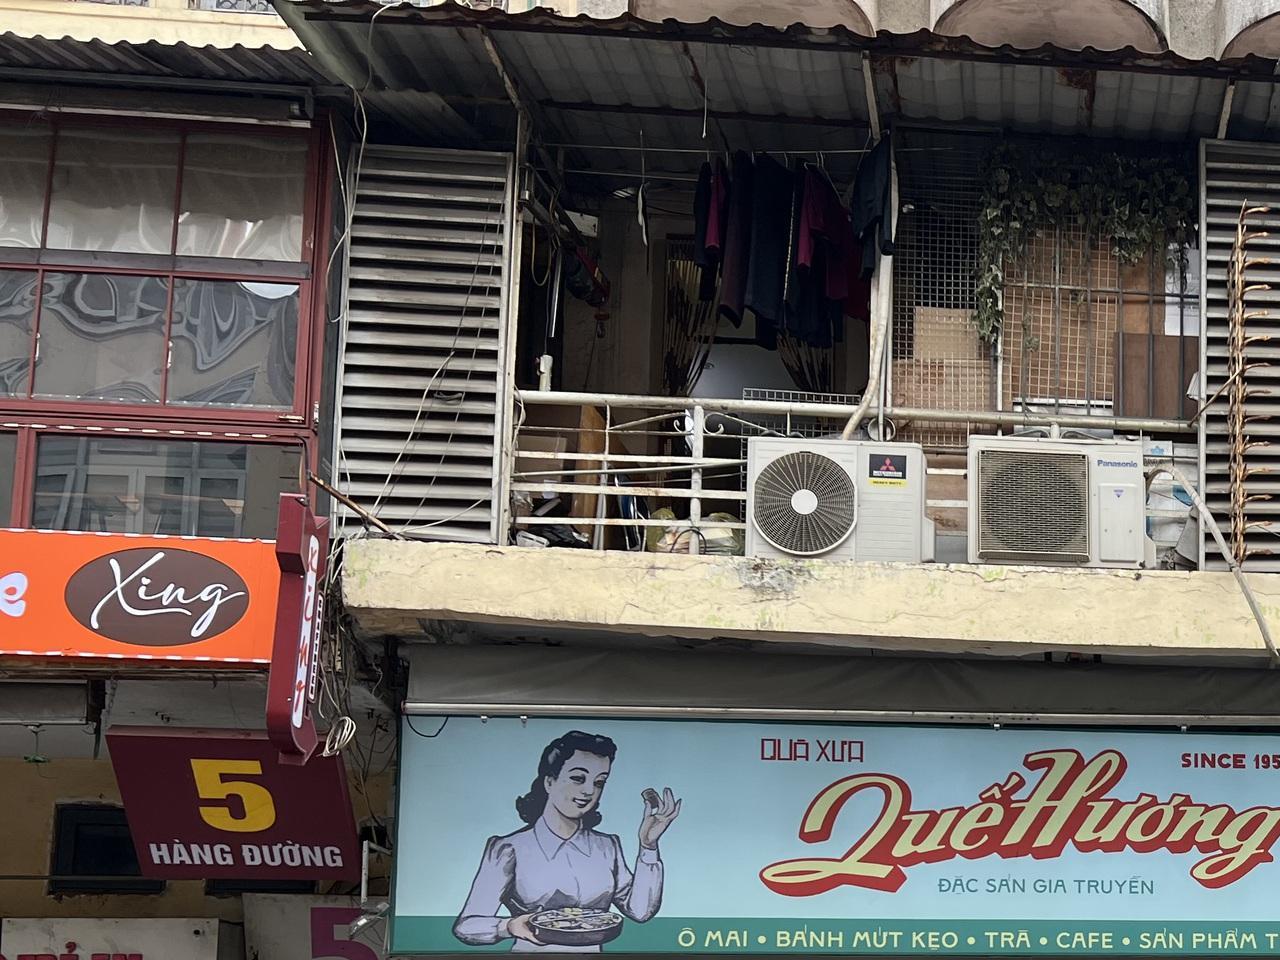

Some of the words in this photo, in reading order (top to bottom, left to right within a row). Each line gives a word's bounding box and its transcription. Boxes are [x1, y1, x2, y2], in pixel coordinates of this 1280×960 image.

[1097, 459, 1138, 468] Panasonic
[91, 551, 246, 638] Xing
[816, 739, 864, 762] XƯA
[1181, 753, 1246, 770] SINCE
[190, 758, 277, 833] 5
[150, 839, 235, 866] HÀNG
[242, 840, 344, 868] ĐƯỜNG
[938, 875, 978, 894] ĐẶC
[1033, 878, 1067, 893] GIA
[678, 927, 696, 948] Ô
[705, 930, 748, 947] MAI
[912, 931, 959, 950] KẸO
[1056, 931, 1113, 949] CAFE
